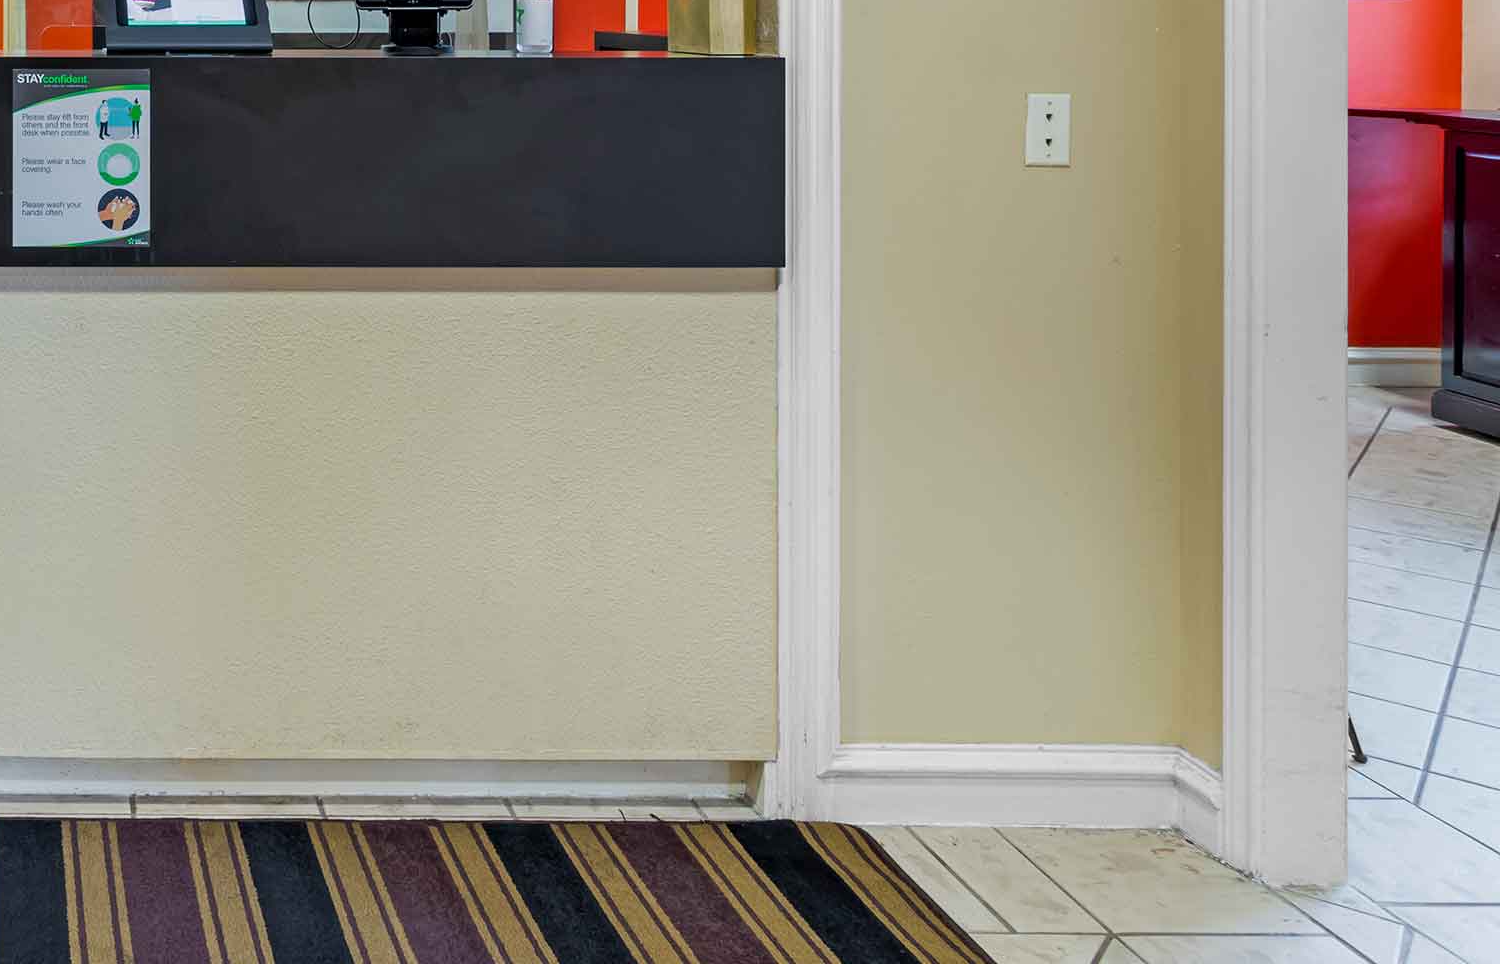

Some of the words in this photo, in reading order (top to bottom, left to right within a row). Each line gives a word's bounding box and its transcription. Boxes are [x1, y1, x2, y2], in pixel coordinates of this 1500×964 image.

[47, 114, 60, 123] stay
[46, 121, 59, 129] and
[60, 121, 71, 129] the
[73, 121, 89, 129] front
[21, 157, 45, 165] Please
[71, 157, 87, 165] face
[21, 201, 45, 209] Please
[47, 201, 64, 209] wash
[65, 202, 83, 211] your
